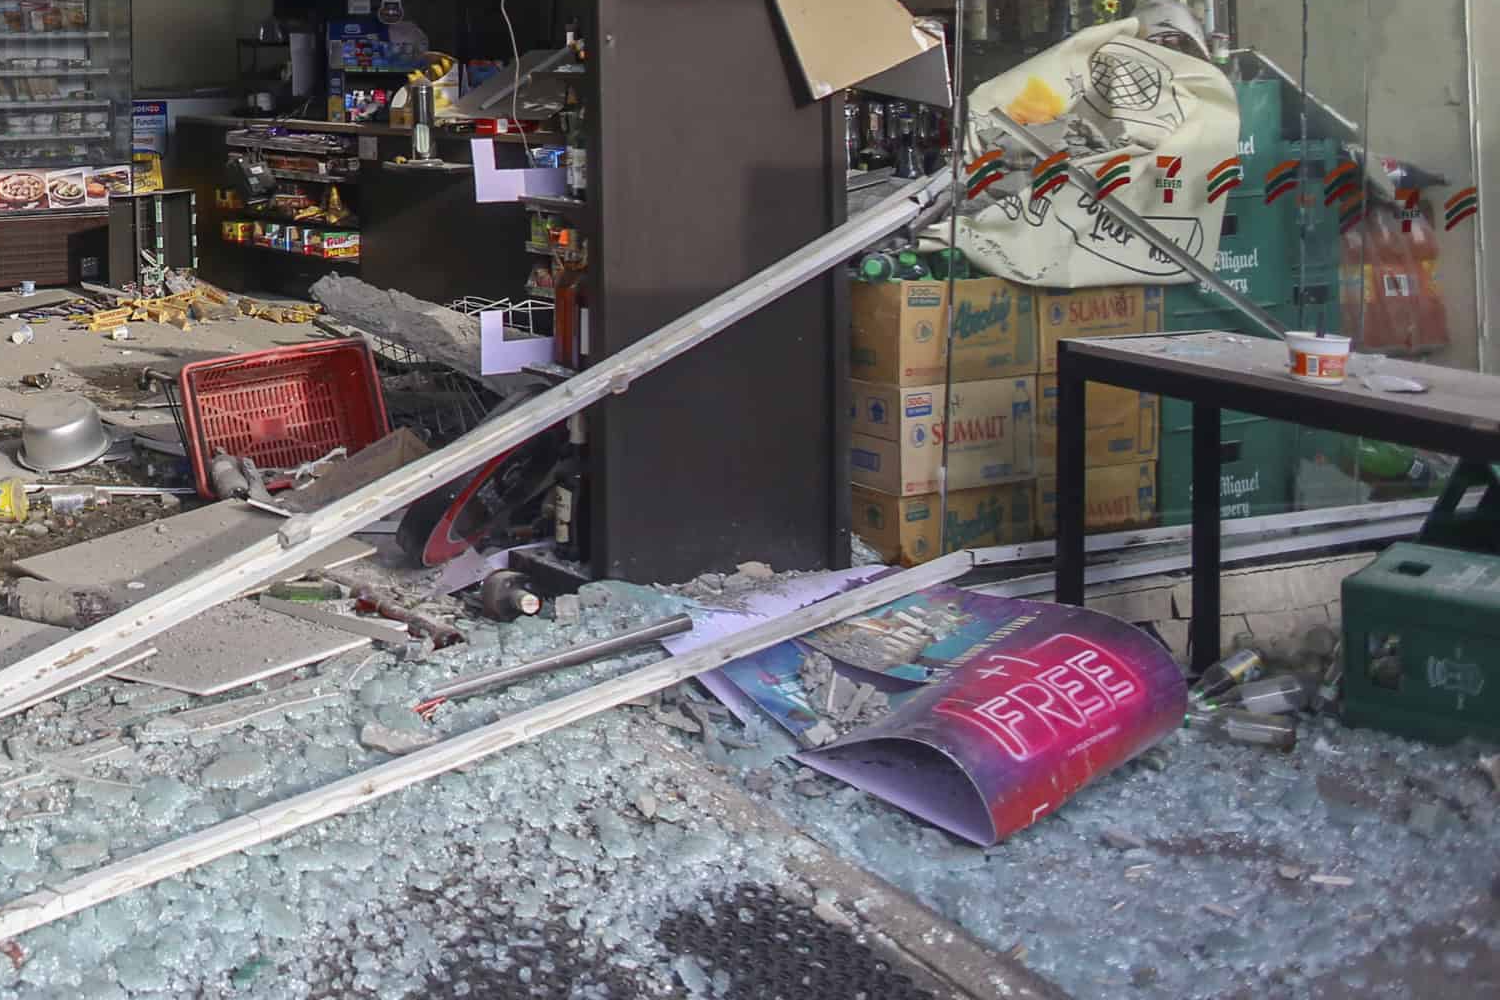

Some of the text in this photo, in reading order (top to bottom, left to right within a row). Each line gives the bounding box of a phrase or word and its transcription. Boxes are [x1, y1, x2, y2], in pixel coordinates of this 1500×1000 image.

[1156, 156, 1182, 203] 7
[931, 415, 1008, 447] SUMMIT
[973, 649, 1136, 761] FREE
